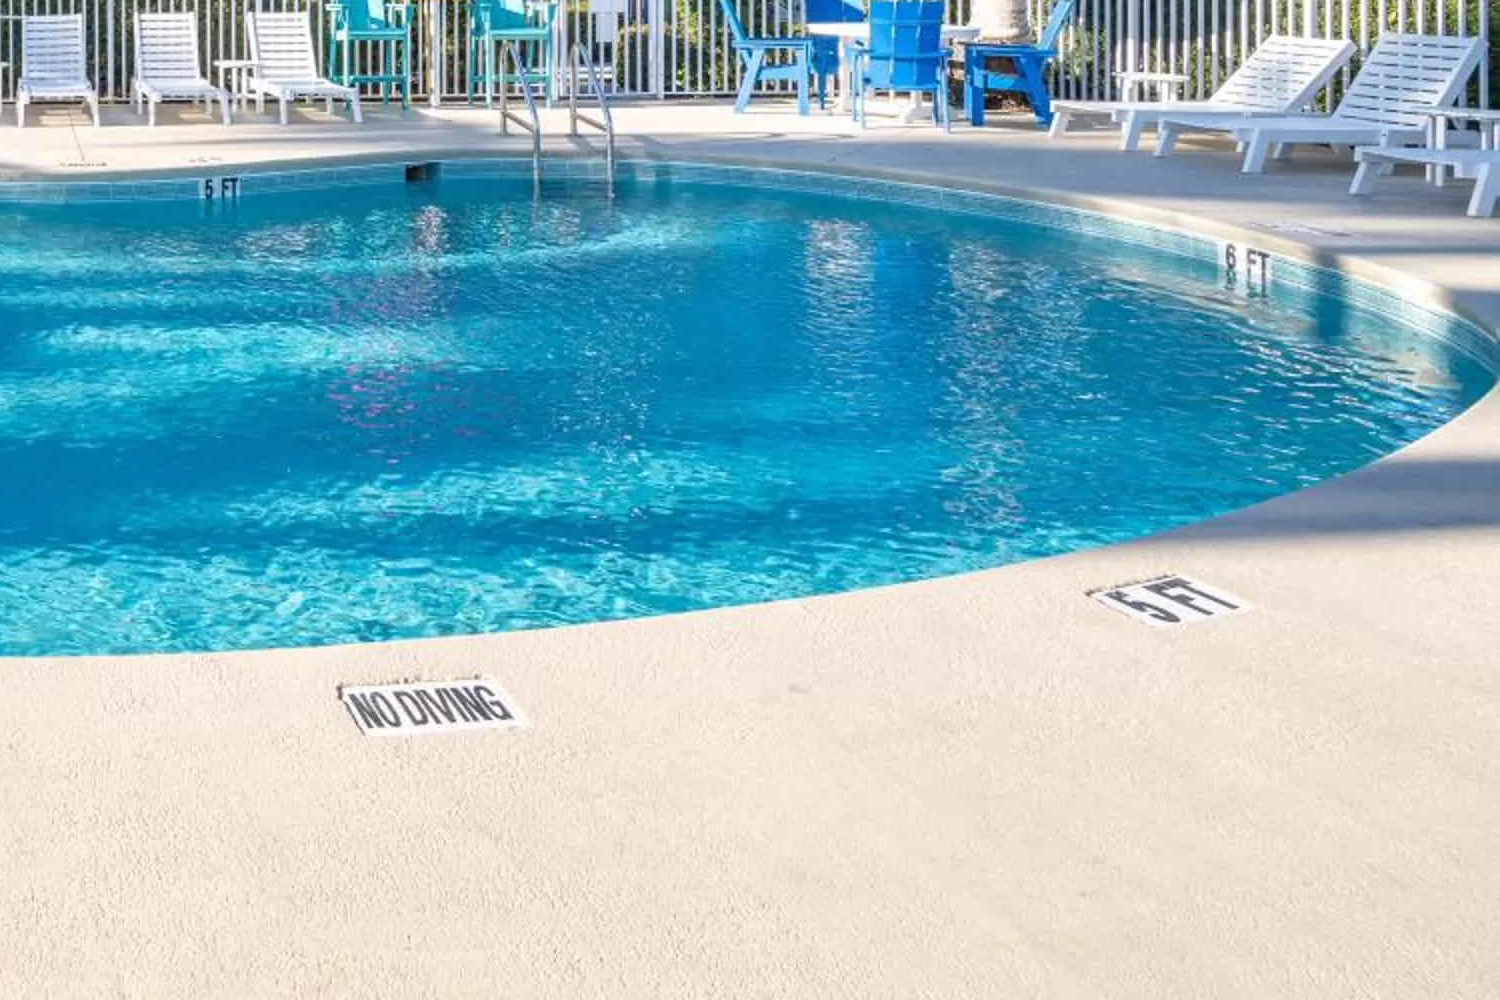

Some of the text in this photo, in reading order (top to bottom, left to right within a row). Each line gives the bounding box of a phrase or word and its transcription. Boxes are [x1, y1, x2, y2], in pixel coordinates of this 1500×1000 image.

[205, 177, 239, 199] 5 FT
[1225, 244, 1271, 278] 6 FT
[1105, 577, 1240, 623] 5 FT
[347, 685, 515, 729] NO DIVING
